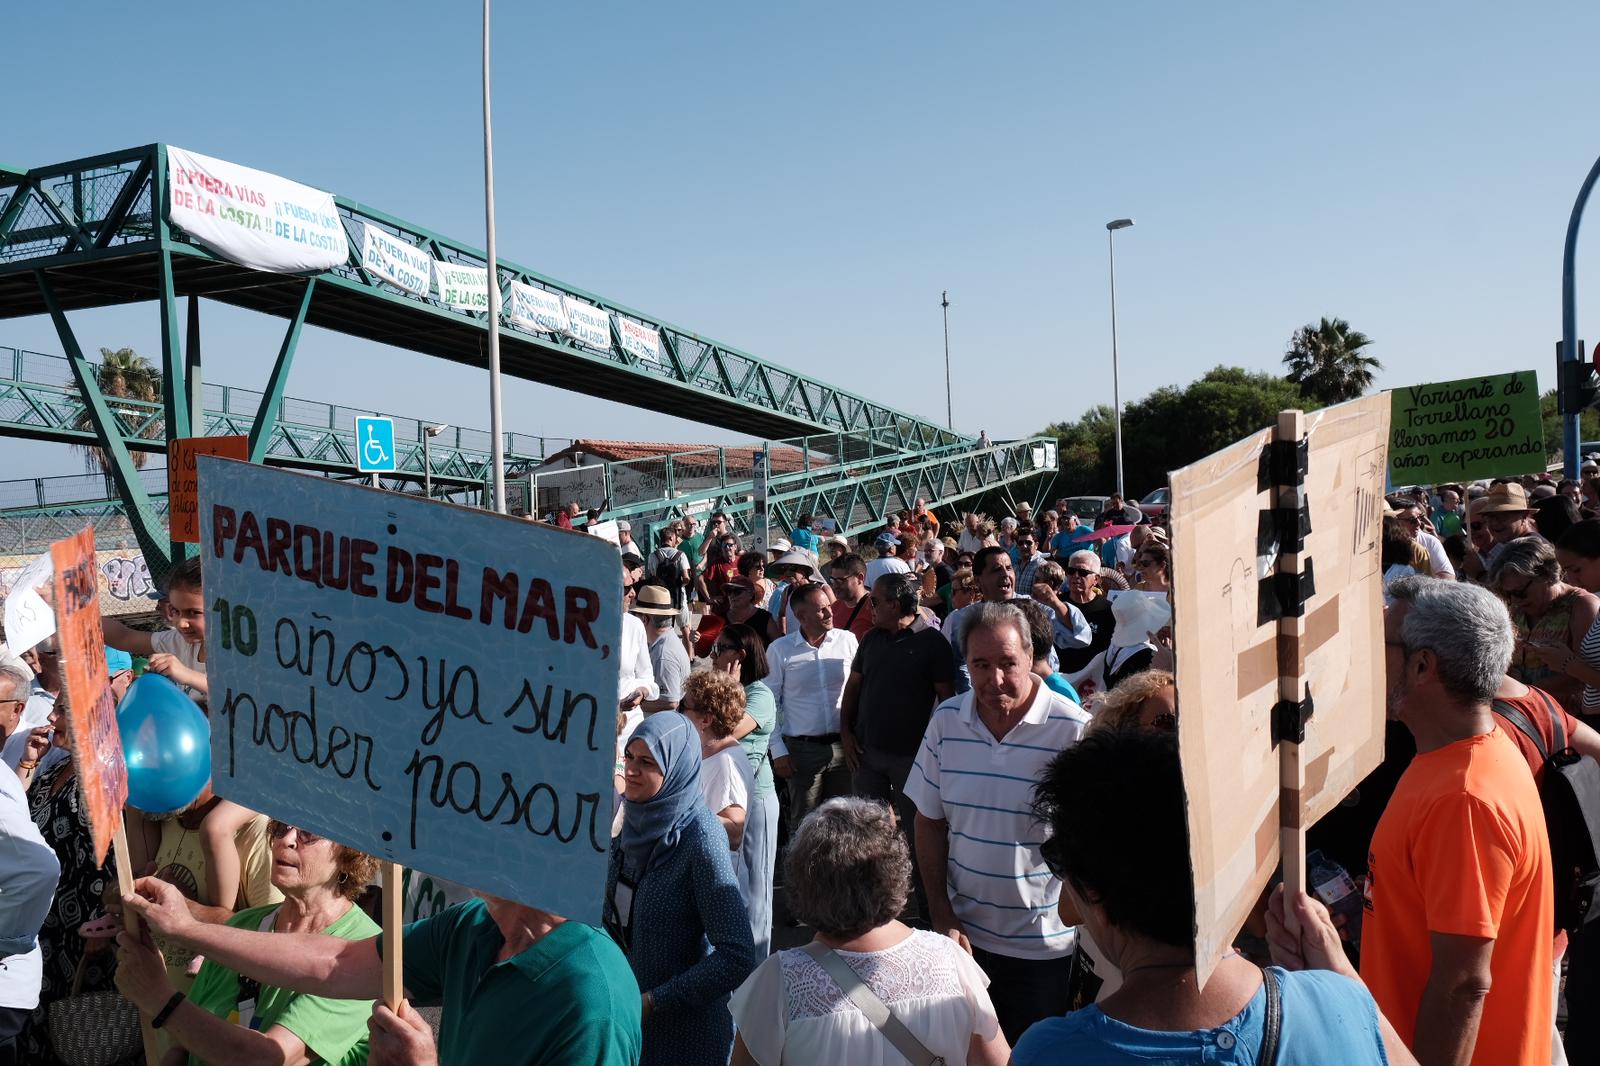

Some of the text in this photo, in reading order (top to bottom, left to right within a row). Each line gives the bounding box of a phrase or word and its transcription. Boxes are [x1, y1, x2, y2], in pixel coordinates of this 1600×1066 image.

[187, 168, 234, 199] FUERA
[175, 188, 193, 209] DE
[197, 195, 216, 217] LA
[219, 204, 262, 231] COSTA
[284, 201, 318, 225] FUERA
[275, 221, 290, 239] DE
[293, 225, 307, 244] LA
[309, 231, 340, 254] COSTA
[377, 237, 410, 265] FUERA
[368, 249, 424, 293] DE LA COSTA
[444, 288, 458, 303] DE
[459, 290, 470, 305] LA
[579, 325, 588, 339] LA
[1409, 372, 1526, 407] Variante de
[1404, 402, 1511, 428] Torrellano
[1393, 416, 1516, 449] llevamos 20
[1393, 436, 1543, 471] años esperando
[212, 503, 379, 599] PARQUE
[386, 543, 473, 621] DEL
[479, 565, 611, 661] MAR,
[212, 597, 599, 752] 10 años ya sin
[221, 685, 382, 792] poder
[404, 748, 607, 854] pasar
